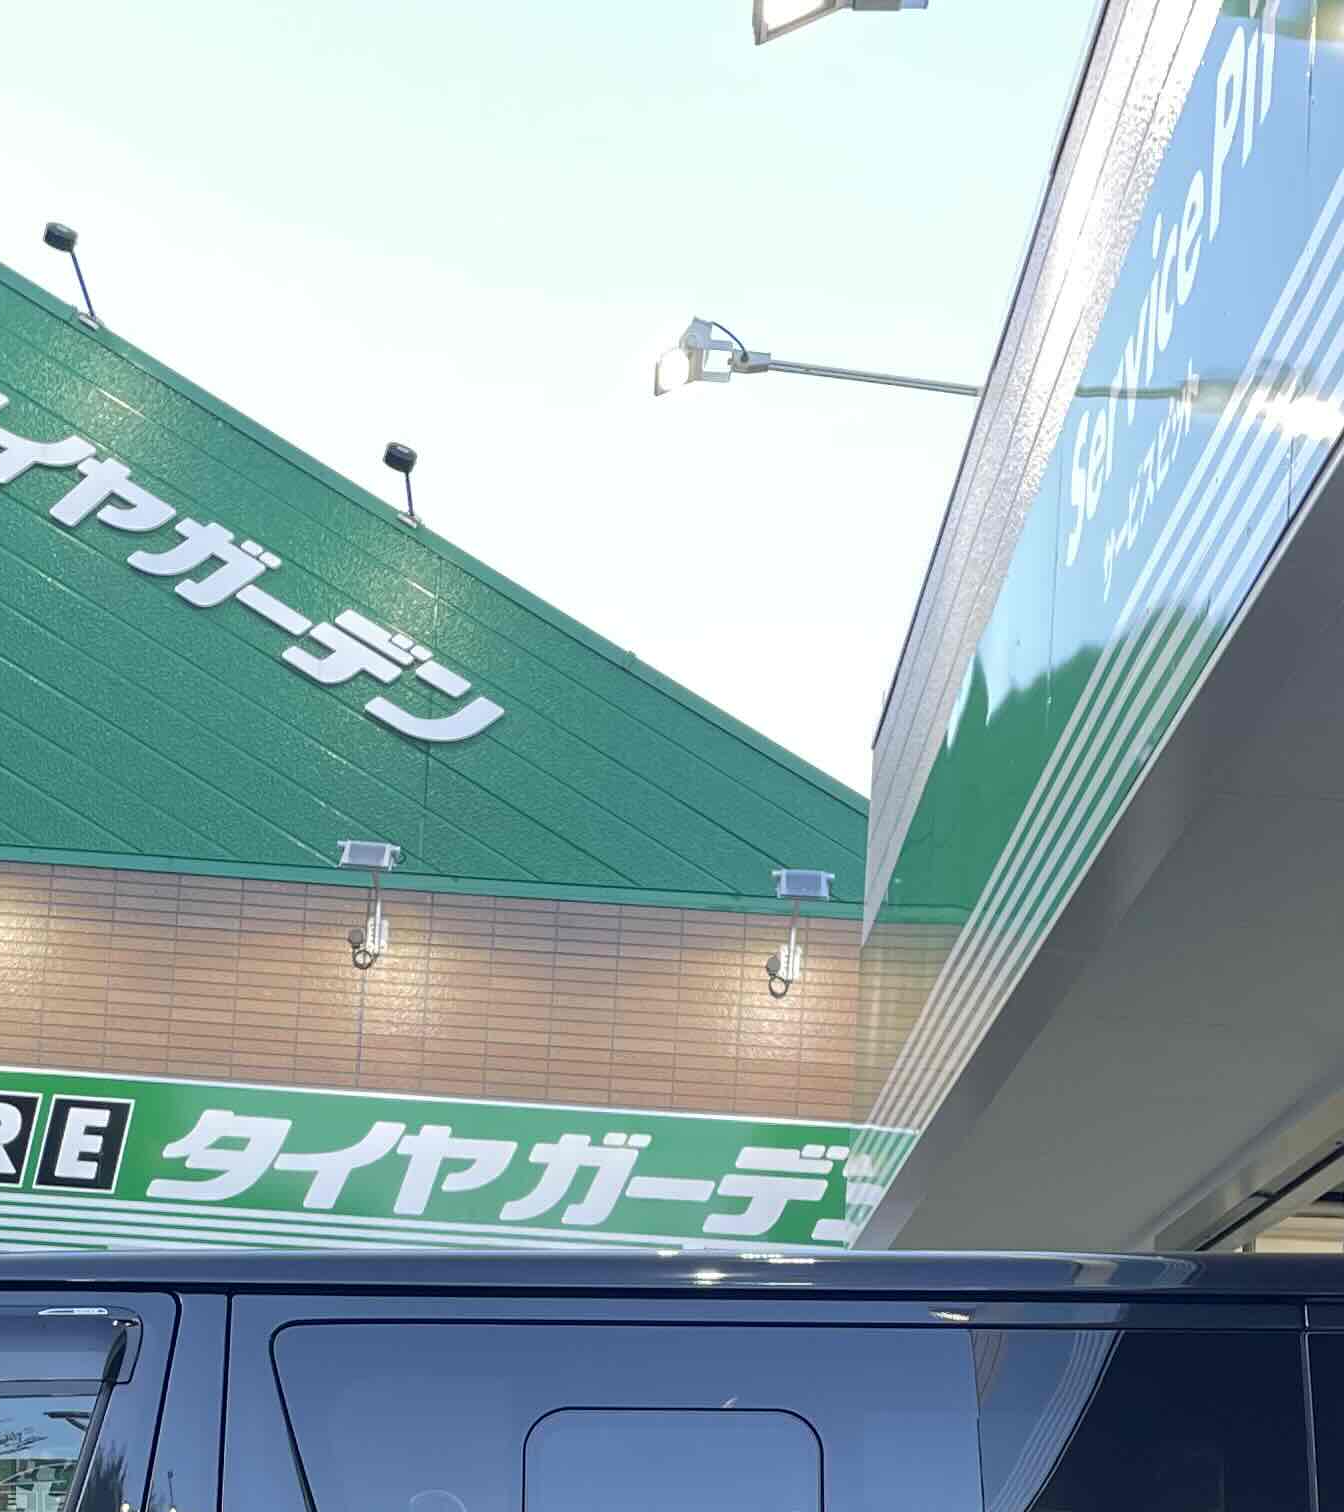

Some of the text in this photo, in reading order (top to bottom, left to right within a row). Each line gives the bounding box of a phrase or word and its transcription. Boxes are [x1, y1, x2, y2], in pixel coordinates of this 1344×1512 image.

[1065, 168, 1206, 567] Service
[146, 1108, 850, 1242] タイヤガーデ
